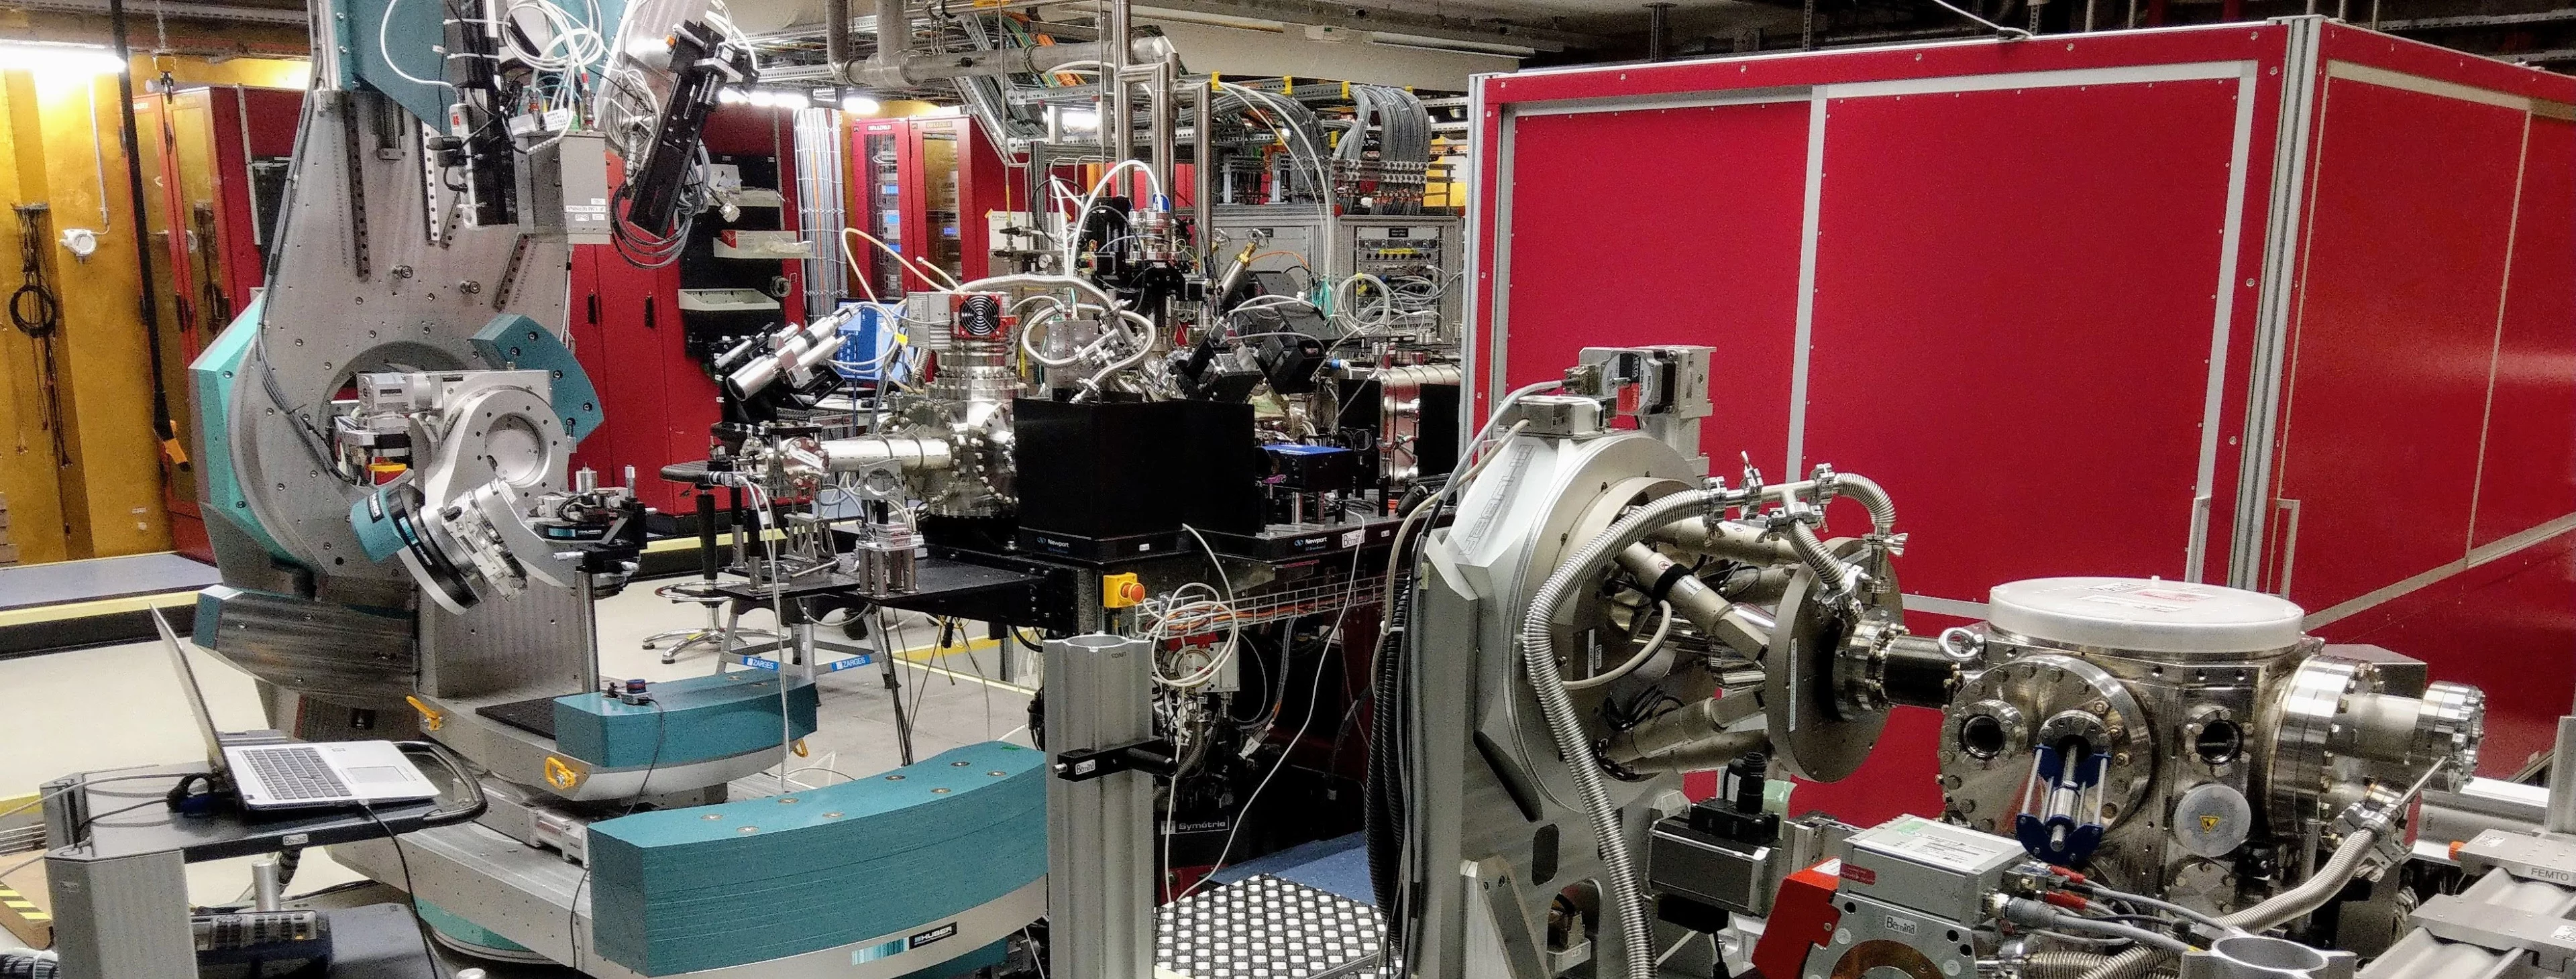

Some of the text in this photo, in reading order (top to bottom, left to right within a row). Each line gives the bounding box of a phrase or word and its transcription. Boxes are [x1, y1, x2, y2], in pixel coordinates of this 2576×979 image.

[1458, 461, 1524, 556] HUBER
[1047, 538, 1070, 548] Newport
[1305, 536, 1328, 544] Newport
[753, 659, 774, 669] ZARGES
[843, 657, 866, 668] ZARGES
[2531, 868, 2570, 881] FEMTO
[1886, 917, 1915, 935] Bernina
[921, 925, 953, 941] HUBER
